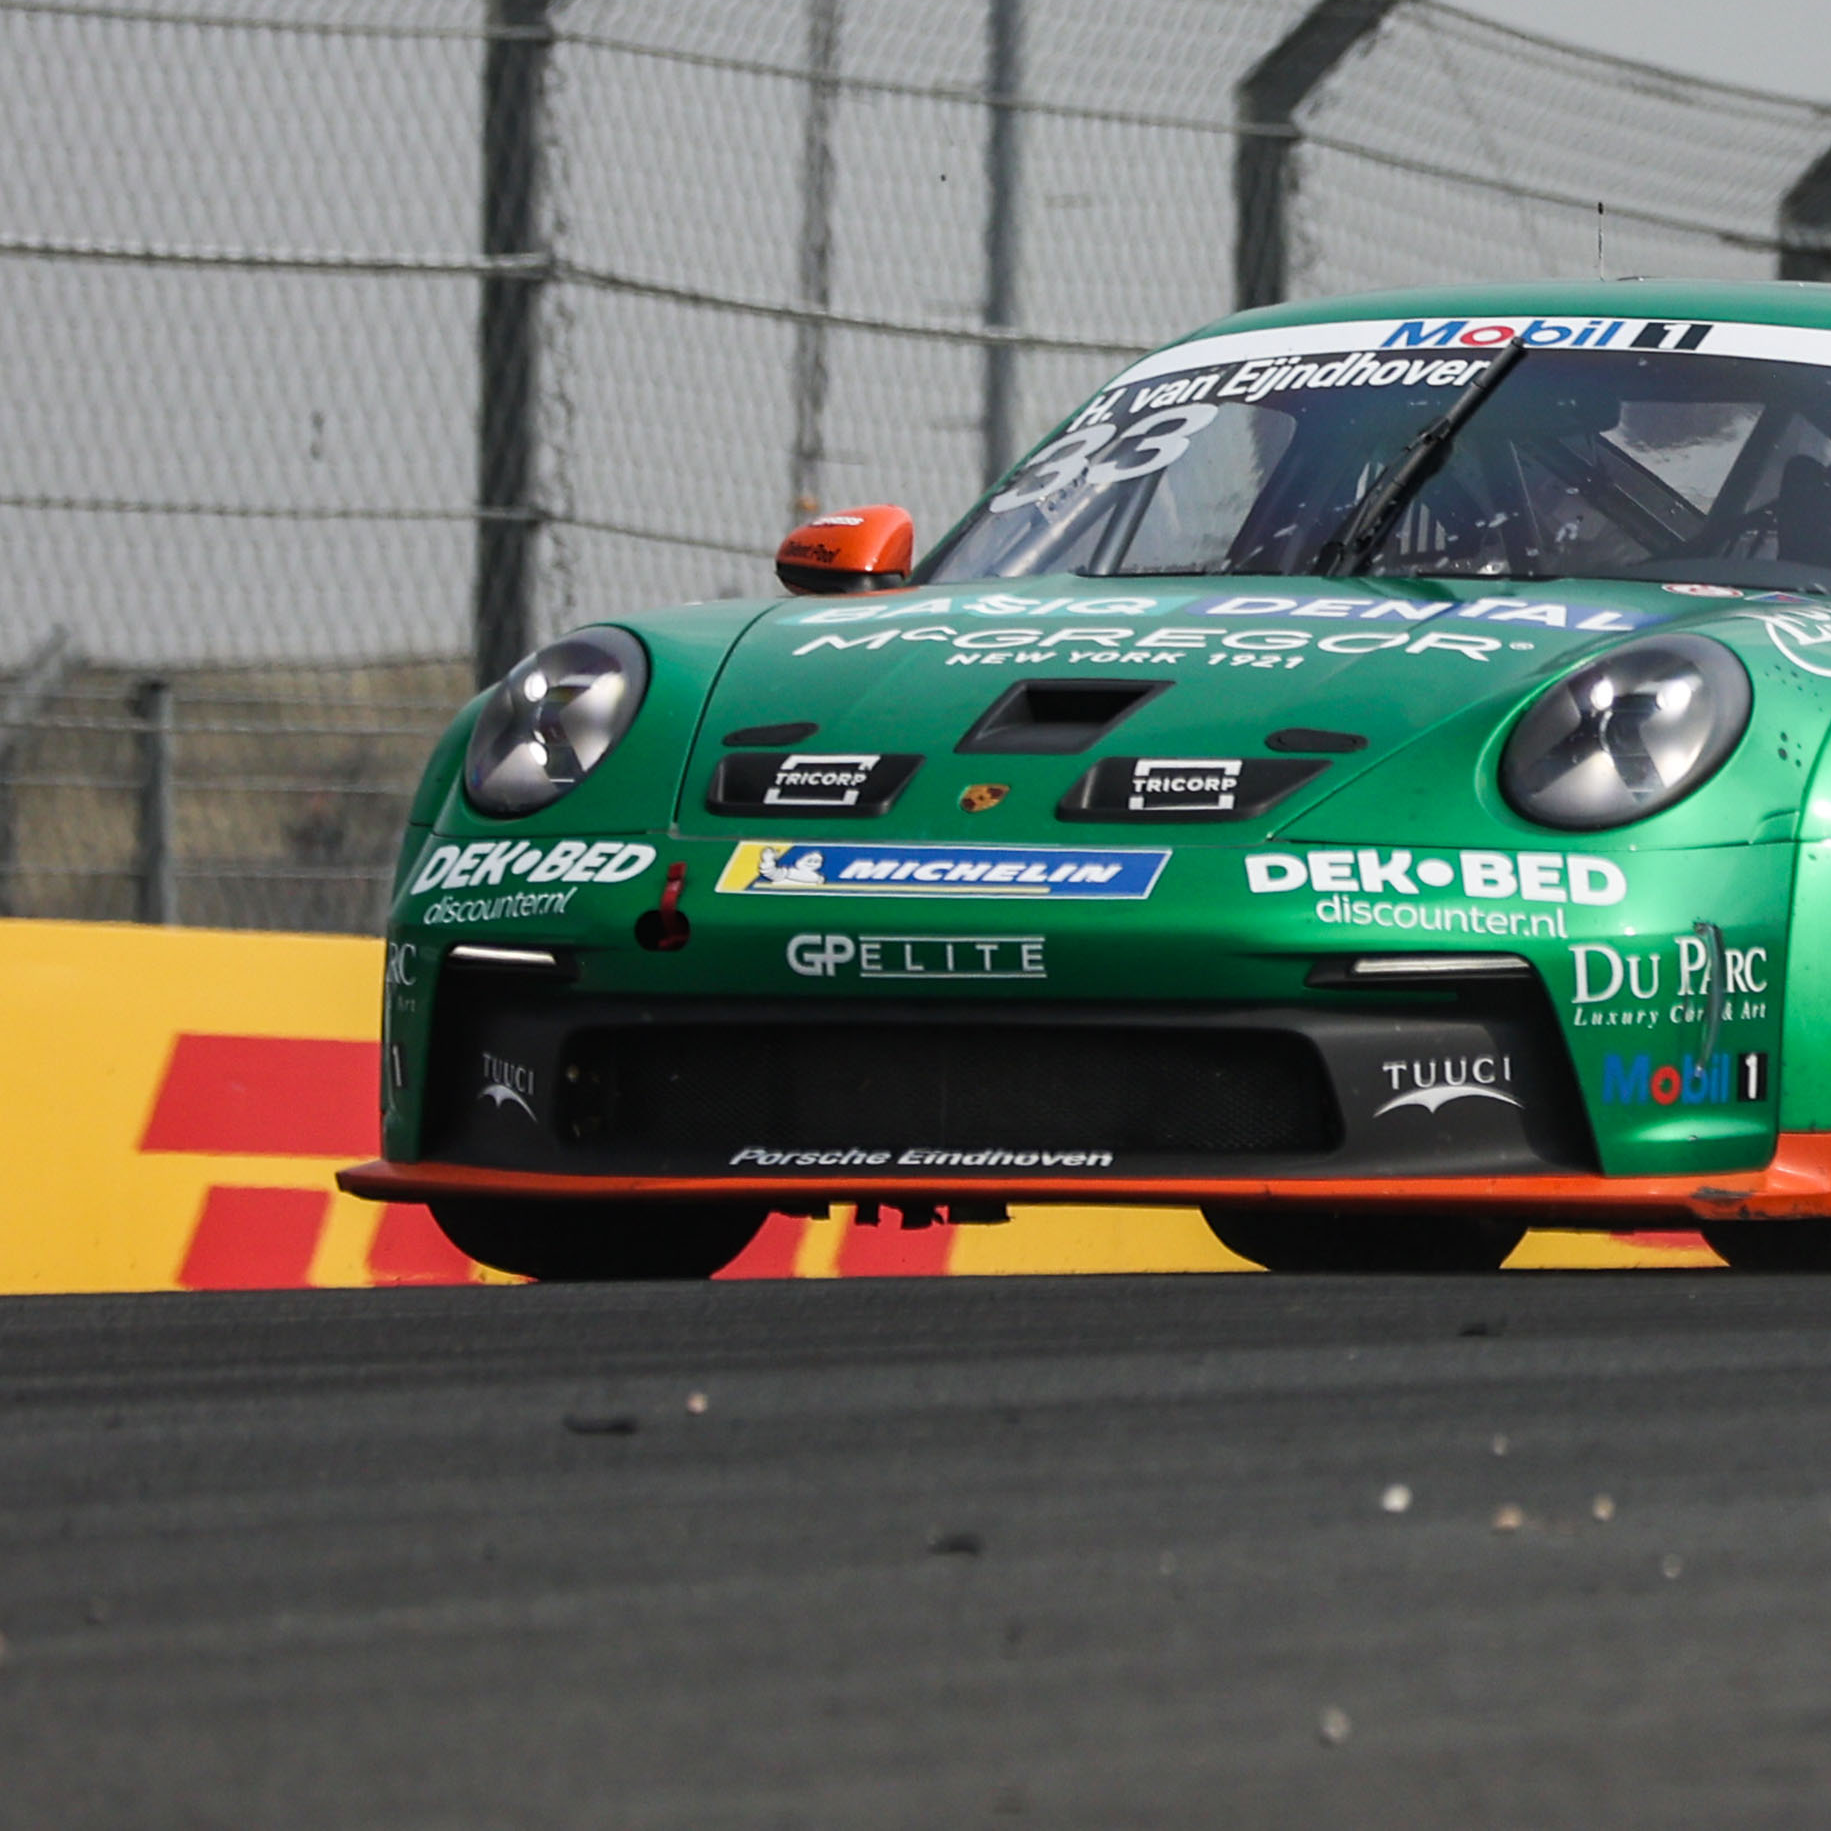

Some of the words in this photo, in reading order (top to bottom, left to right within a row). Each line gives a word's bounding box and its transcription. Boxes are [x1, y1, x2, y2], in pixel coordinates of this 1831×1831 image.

[1380, 319, 1627, 348] Mobil
[1066, 387, 1127, 433] H.
[1129, 376, 1221, 414] van
[989, 402, 1220, 513] 33
[798, 593, 1159, 626] BASIQ
[1204, 595, 1636, 632] DENTAL
[945, 651, 1058, 667] NEW
[1068, 649, 1186, 667] YORK
[1207, 651, 1305, 670] 1921
[774, 771, 867, 788] TRICORP
[1132, 776, 1238, 794] TRICORP
[839, 858, 1123, 884] MICHELIN
[423, 886, 579, 926] discounter.nl
[1315, 894, 1569, 940] discounter.nl
[1573, 1006, 1660, 1029] Luxury
[1740, 999, 1767, 1020] Art
[482, 1051, 535, 1096] TUUCI
[1381, 1055, 1513, 1091] TUUCI
[1602, 1052, 1733, 1105] Mobil
[729, 1146, 891, 1168] Porsche
[896, 1147, 1114, 1169] Eindhoven
